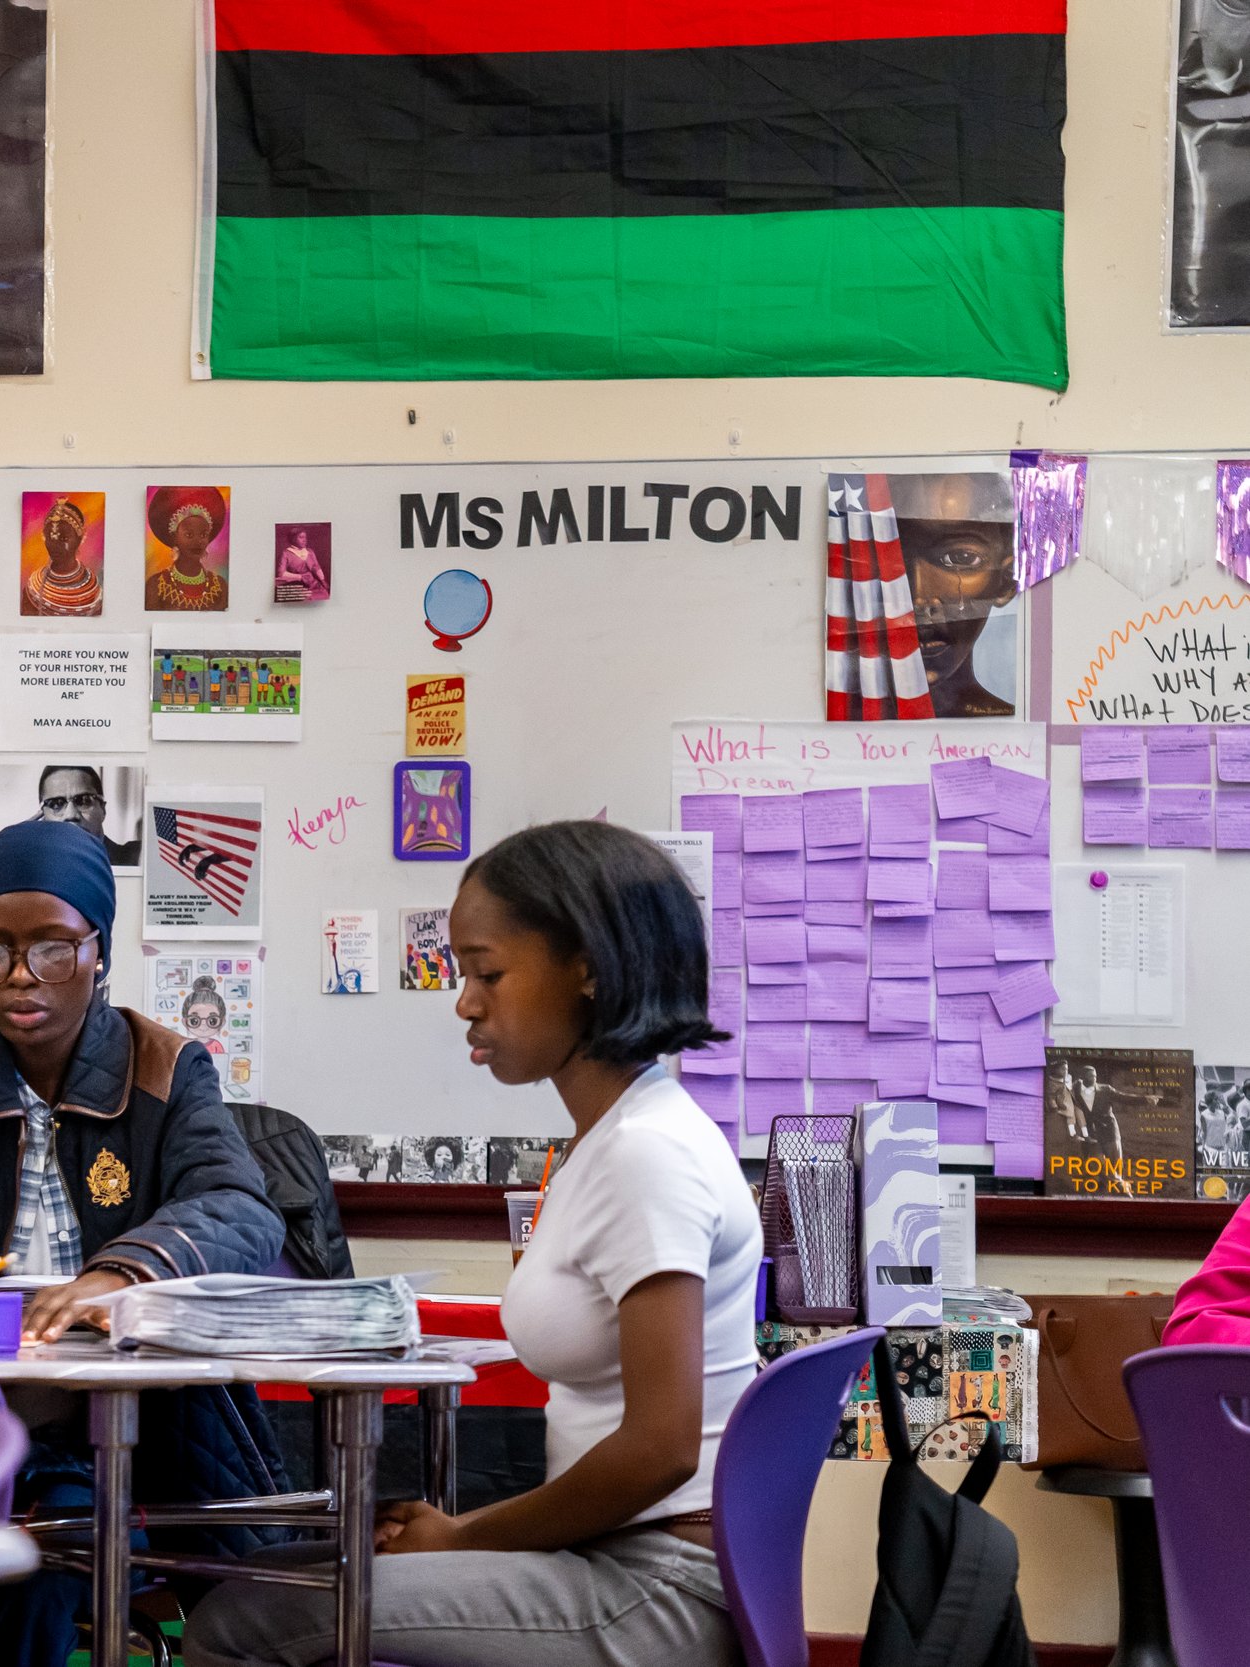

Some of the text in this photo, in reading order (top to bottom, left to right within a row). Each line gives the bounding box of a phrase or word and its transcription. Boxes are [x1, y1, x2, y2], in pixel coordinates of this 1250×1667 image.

[517, 482, 802, 548] MILTON
[43, 650, 72, 659] MORE
[75, 650, 95, 659] YOU
[98, 651, 129, 659] KNOW
[19, 664, 127, 674] OF YOUR HISTORY, THE
[20, 678, 126, 687] MORE LIBERATED YOU
[425, 680, 447, 694] WE
[1152, 666, 1216, 697] WHY
[411, 687, 462, 710] DEMAND
[415, 710, 432, 718] AN
[33, 719, 111, 728] MAYA ANGELOU
[424, 720, 450, 728] POLICE
[416, 727, 456, 735] BRUTALITY
[415, 732, 462, 747] NOW!
[681, 724, 777, 764] What
[800, 738, 831, 761] is
[855, 732, 918, 763] Your
[287, 795, 367, 850] Kenya
[416, 920, 437, 932] LAWS
[1156, 1067, 1186, 1075] JACKIE
[1050, 1156, 1187, 1179] PROMISES
[1071, 1178, 1164, 1195] TO KEEP
